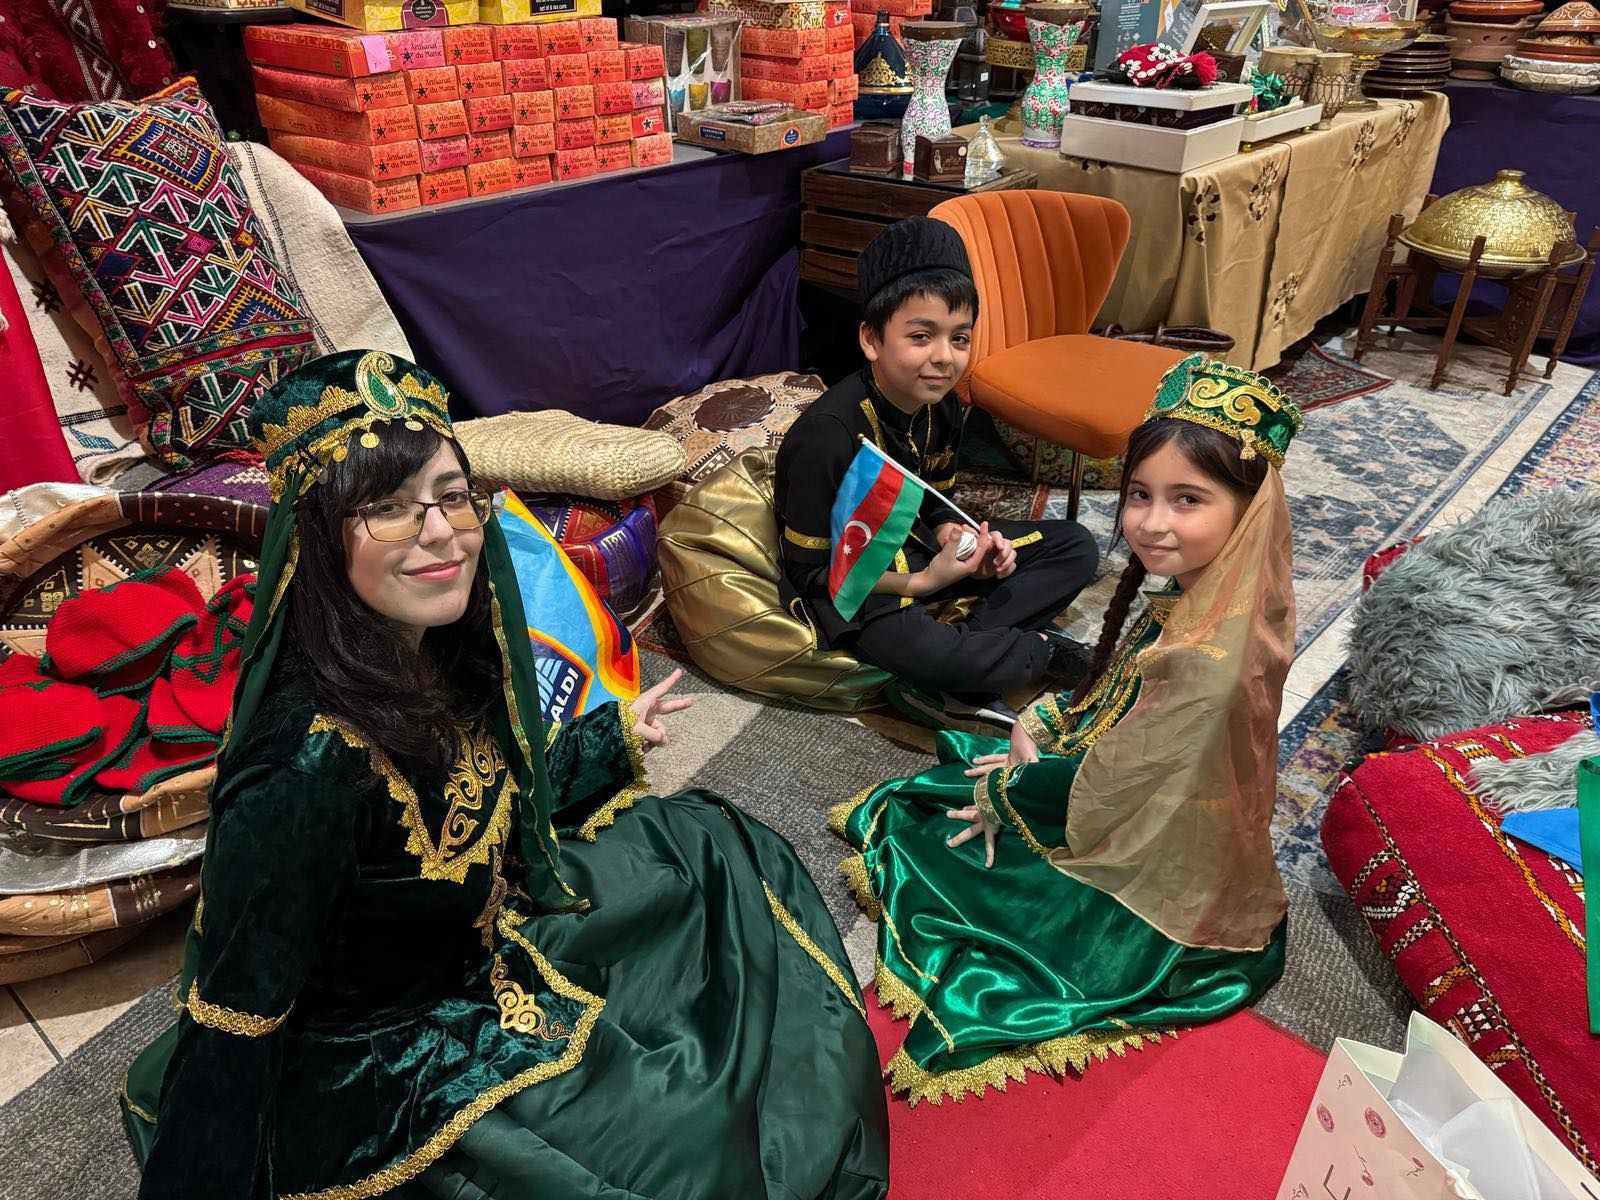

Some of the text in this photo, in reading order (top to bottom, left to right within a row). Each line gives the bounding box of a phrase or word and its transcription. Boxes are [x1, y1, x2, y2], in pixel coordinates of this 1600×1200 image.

[424, 50, 442, 58] Maroc
[385, 90, 404, 98] Maroc
[400, 159, 418, 167] Maroc
[389, 195, 398, 203] du
[550, 666, 580, 722] ALDI
